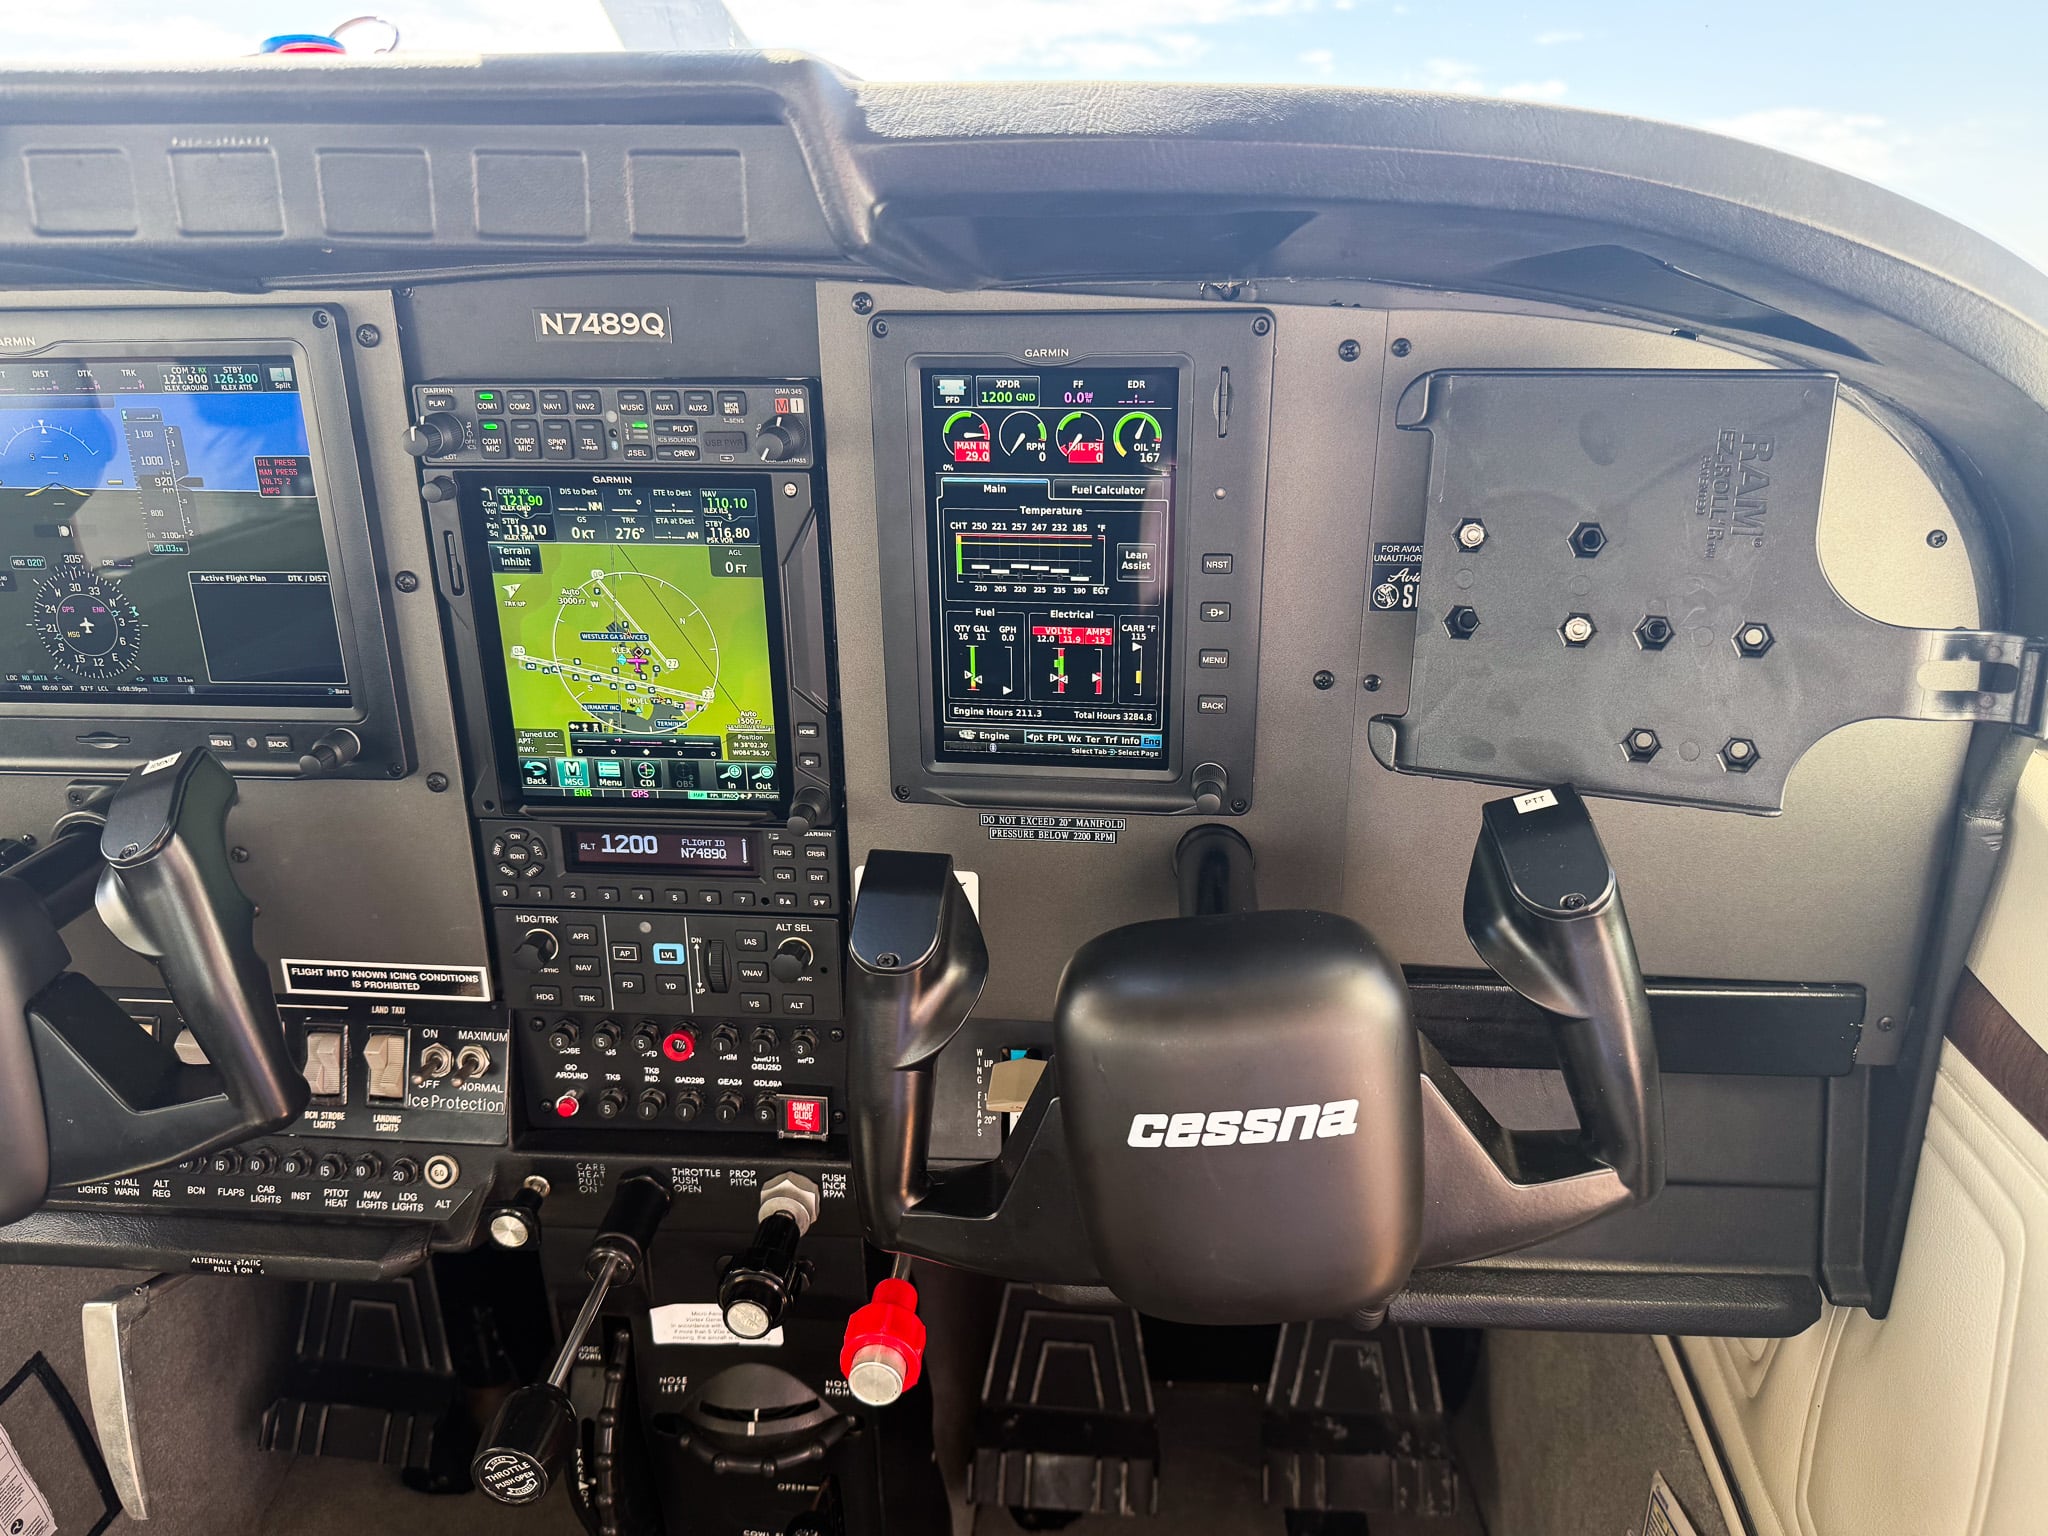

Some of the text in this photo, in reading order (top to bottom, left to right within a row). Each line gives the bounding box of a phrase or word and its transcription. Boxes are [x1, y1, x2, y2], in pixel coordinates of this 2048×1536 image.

[540, 313, 666, 337] N7489Q
[1024, 349, 1069, 357] GARMIN
[223, 366, 242, 374] STBY
[163, 374, 208, 385] 121.900
[214, 374, 258, 384] 126.300
[981, 392, 1035, 403] 1200 GND
[621, 404, 644, 412] MUSIC
[689, 404, 708, 412] AUX2
[482, 438, 501, 446] COM1
[514, 438, 535, 446] COM2
[1027, 443, 1045, 451] RPM
[966, 452, 989, 461] 29.0
[1140, 453, 1159, 462] 167
[259, 468, 298, 476] MAN PRESS
[984, 485, 1006, 493] Main
[1072, 486, 1145, 495] Fuel Calculator
[504, 496, 543, 506] 121.90
[707, 498, 748, 508] 110.10
[1020, 506, 1082, 516] Temperature
[1031, 523, 1047, 531] 247
[1072, 524, 1087, 532] 185
[497, 547, 531, 555] Terrain
[1125, 551, 1148, 559] Lean
[501, 557, 531, 566] Inhibit
[1122, 562, 1150, 570] Assist
[1206, 561, 1228, 569] NRST
[201, 574, 224, 582] Active
[226, 574, 249, 583] Flight
[975, 609, 995, 617] Fuel
[1050, 610, 1093, 619] Electrical
[1203, 656, 1225, 664] MENU
[1202, 702, 1223, 710] BACK
[954, 708, 1042, 717] Engine Hours 211.3
[1074, 711, 1152, 721] Total Hours 3284.8
[980, 732, 1009, 741] Engine
[211, 739, 231, 747] MENU
[526, 777, 547, 785] Back
[564, 778, 584, 787] MSG
[599, 779, 622, 787] Menu
[640, 779, 655, 787] CDI
[756, 782, 771, 790] Out
[574, 789, 592, 797] ENR
[631, 790, 649, 799] GPS
[1524, 795, 1545, 806] PTT
[983, 816, 995, 824] DO
[999, 816, 1017, 825] NOT
[1020, 817, 1055, 826] EXCEED
[1076, 819, 1123, 828] MANIFOLD
[991, 830, 1113, 841] PRESSURE BELOW 2200 RPM
[602, 835, 658, 854] 1200
[682, 839, 725, 847] FLIGHT ID
[681, 848, 727, 860] N7489Q
[516, 915, 558, 924] HDG/TRK
[776, 923, 812, 932] ALT SEL
[573, 932, 589, 940] APR
[744, 938, 757, 946] IAS
[661, 951, 675, 959] LVL
[576, 964, 592, 972] NAV
[291, 967, 479, 983] FLIGHT INTO KNOWN ICING CONDITIONS
[351, 980, 420, 992] IS PROHIBITED
[790, 1002, 804, 1010] ALT
[422, 1028, 438, 1038] ON
[458, 1030, 508, 1042] MAXIMUM
[408, 1094, 504, 1112] Ice Protection
[792, 1102, 814, 1112] SMART
[304, 1111, 346, 1120] BCN STROBE
[373, 1114, 401, 1124] LANDING
[794, 1111, 812, 1120] GLIDE
[313, 1120, 336, 1129] LIGHTS
[376, 1123, 399, 1132] LIGHTS
[1127, 1099, 1359, 1148] cessna
[672, 1169, 720, 1177] THROTTLE
[730, 1170, 756, 1178] PROP
[822, 1173, 846, 1182] PUSH
[673, 1176, 699, 1185] PUSH
[730, 1178, 757, 1186] PITCH
[187, 1186, 205, 1195] BCN
[257, 1185, 275, 1194] CAB
[674, 1185, 702, 1193] OPEN
[823, 1182, 846, 1190] INCR
[217, 1188, 245, 1197] FLAPS
[291, 1192, 311, 1201] INST
[324, 1189, 349, 1198] PITOT
[363, 1190, 381, 1199] NAV
[399, 1193, 417, 1201] LDG
[823, 1190, 845, 1198] RPM
[250, 1194, 281, 1204] LIGHTS
[325, 1198, 348, 1208] HEAT
[356, 1199, 388, 1210] LIGHTS
[392, 1202, 424, 1212] LIGHTS
[435, 1200, 451, 1209] ALT
[659, 1377, 688, 1386] NOSE
[661, 1385, 686, 1393] LEFT
[485, 1462, 530, 1482] THROTTLE
[495, 1471, 535, 1489] PUSH OPEN
